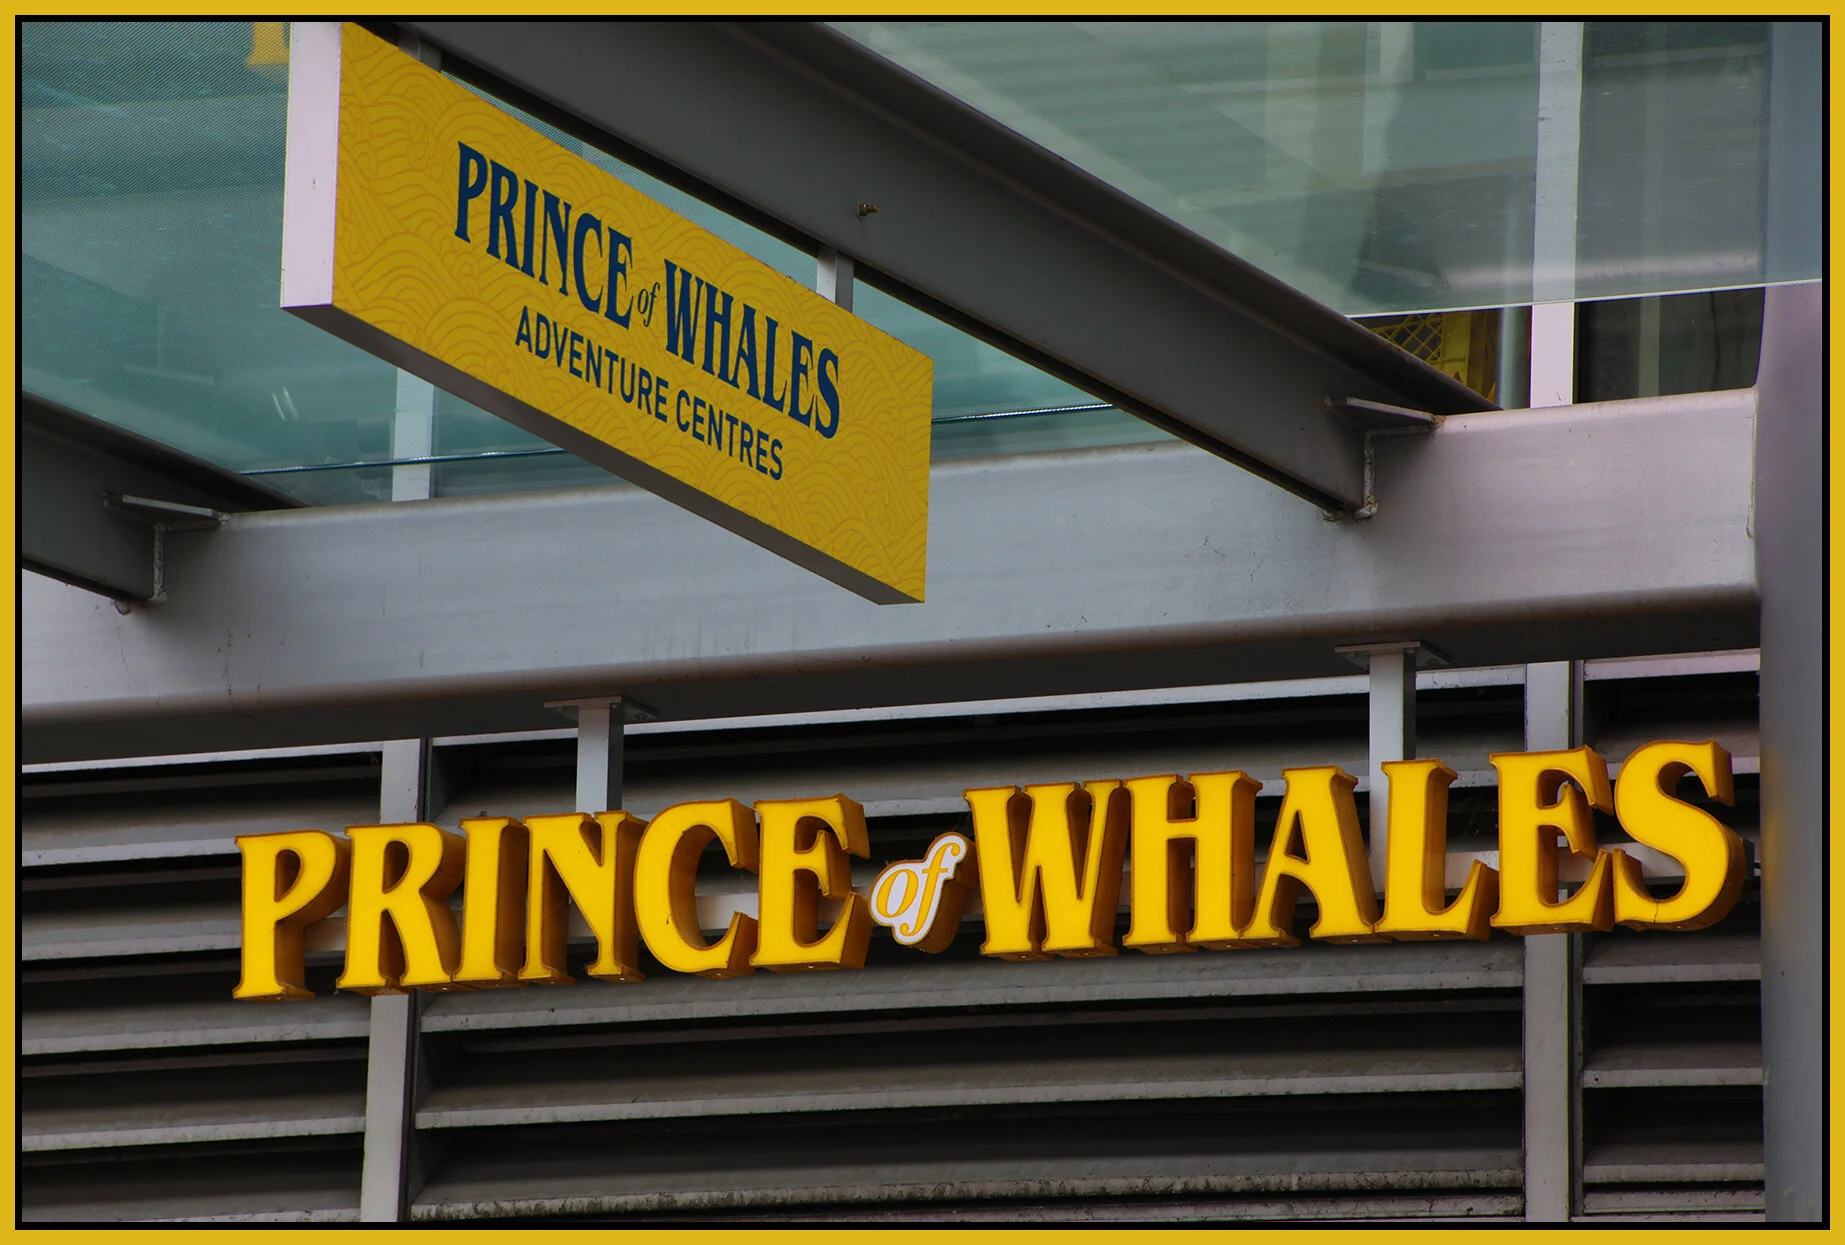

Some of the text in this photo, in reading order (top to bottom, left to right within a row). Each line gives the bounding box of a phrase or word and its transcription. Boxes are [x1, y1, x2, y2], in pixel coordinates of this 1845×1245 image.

[454, 141, 841, 439] PRINCE of WHALES
[515, 305, 784, 481] ADVENTURE CENTRES
[232, 740, 1742, 1001] PRINCE of WHALES
